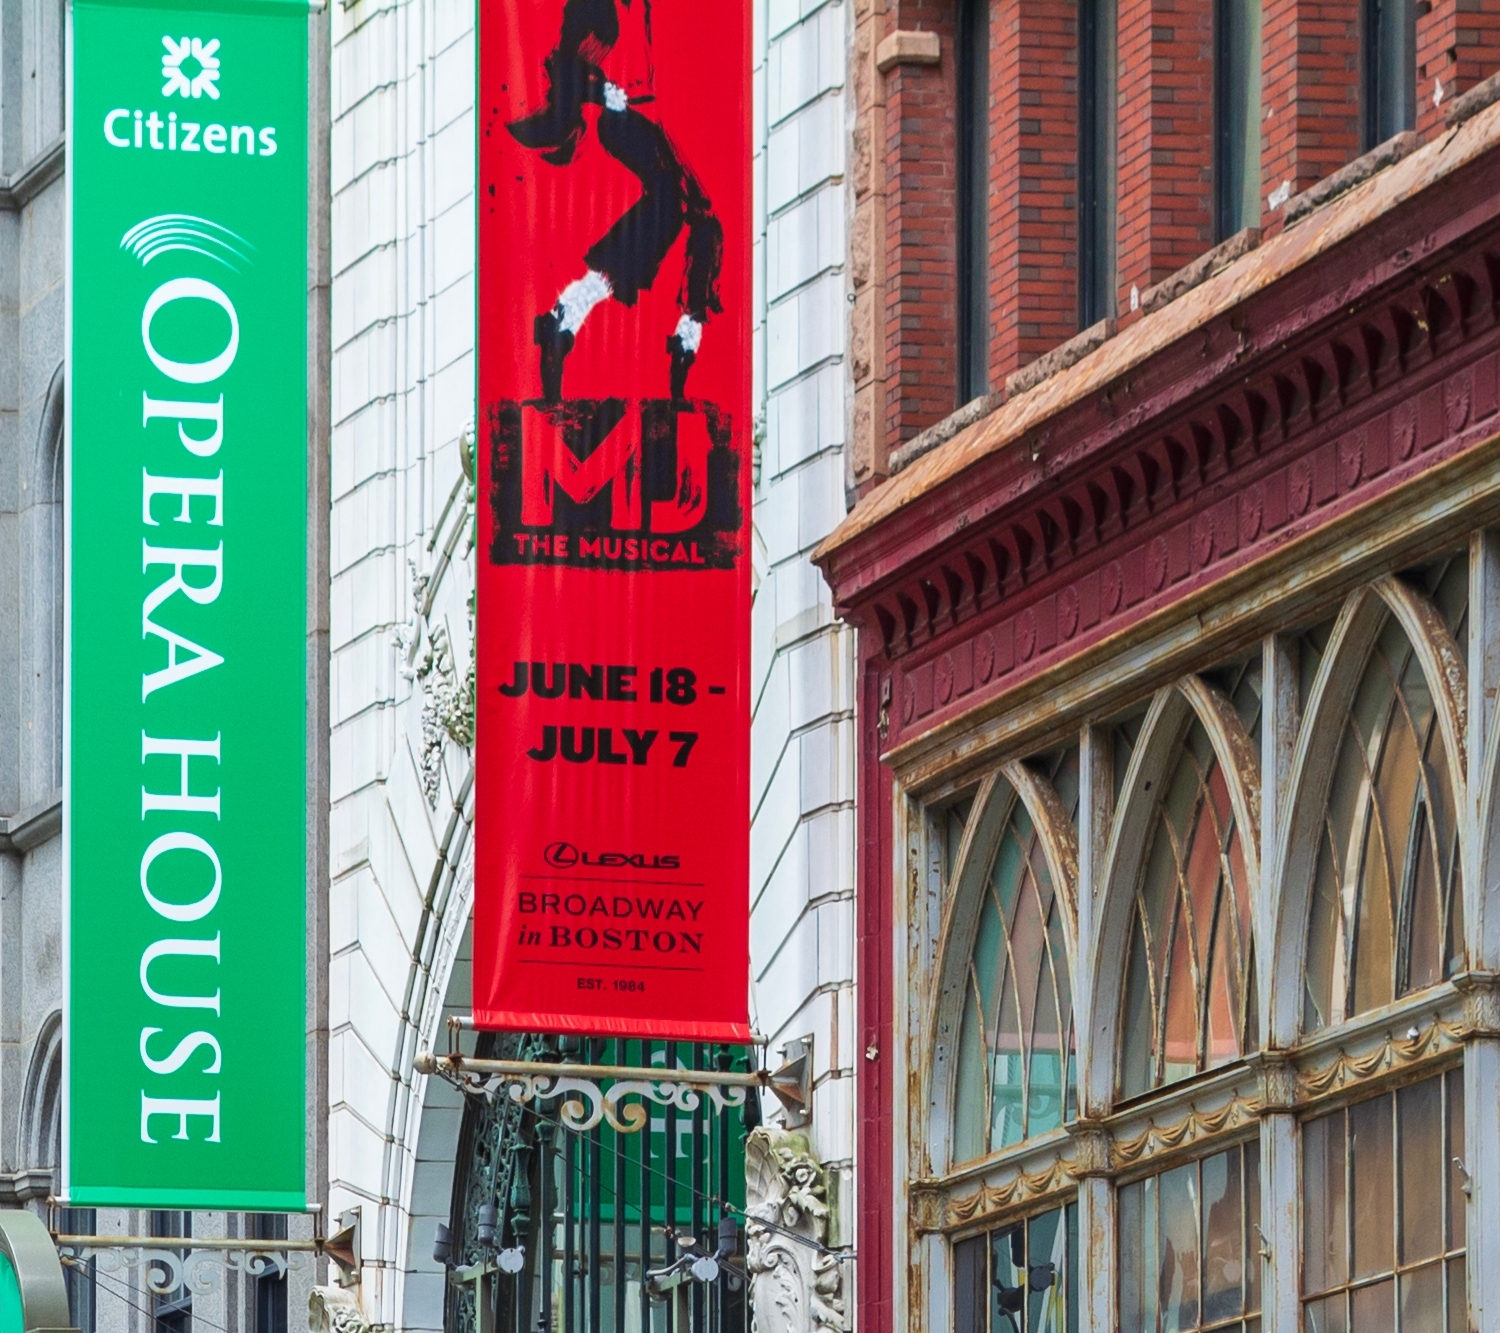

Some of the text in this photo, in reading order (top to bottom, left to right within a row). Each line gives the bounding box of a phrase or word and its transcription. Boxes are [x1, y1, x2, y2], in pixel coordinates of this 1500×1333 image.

[103, 108, 278, 157] Citizens
[521, 404, 708, 534] MJ
[513, 534, 705, 564] THE MUSICAL
[498, 661, 637, 702] JUNE
[650, 667, 697, 706] 18
[139, 276, 239, 1146] OPERA HOUSE
[527, 725, 699, 768] JULY 7
[582, 852, 680, 869] LEXUS
[518, 891, 704, 921] BROADWAY
[518, 925, 703, 953] in BOSTON
[577, 978, 645, 992] EST. 1984
